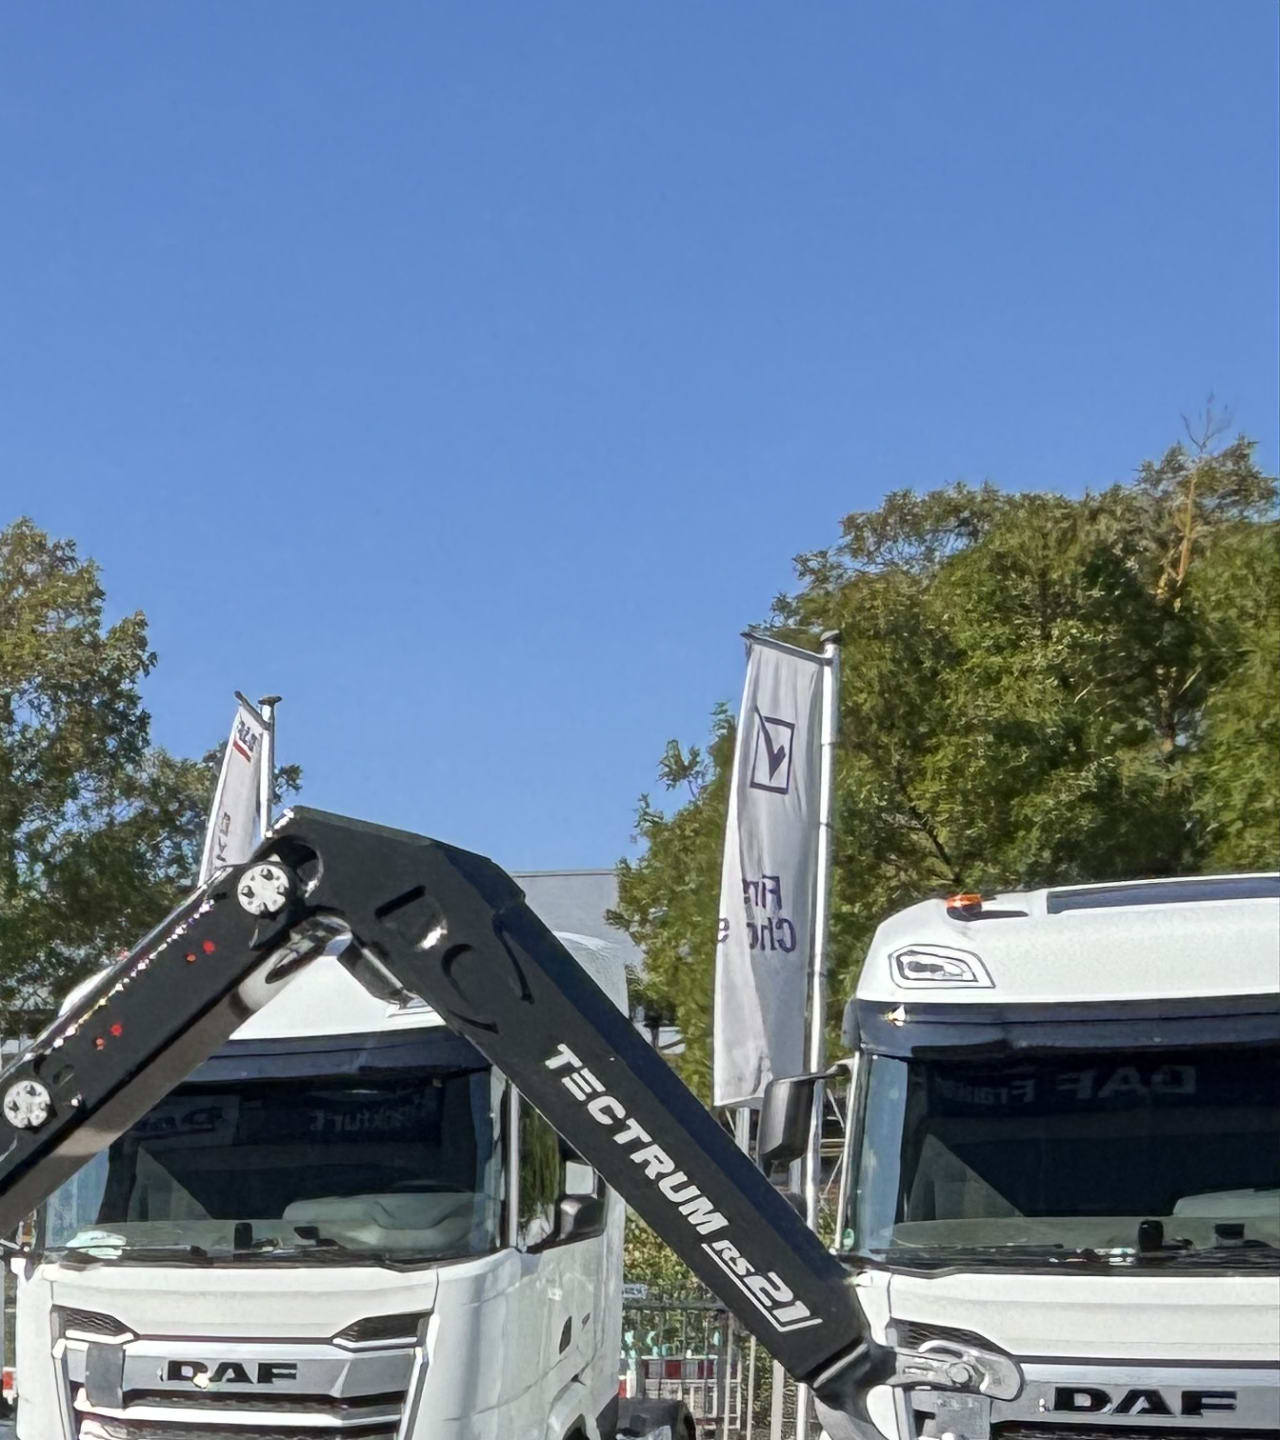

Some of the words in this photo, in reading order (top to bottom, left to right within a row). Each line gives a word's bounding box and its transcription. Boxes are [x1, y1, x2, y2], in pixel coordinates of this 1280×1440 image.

[544, 1043, 730, 1236] TECTRUM
[167, 1360, 298, 1384] DAF
[1053, 1386, 1237, 1416] DAF
